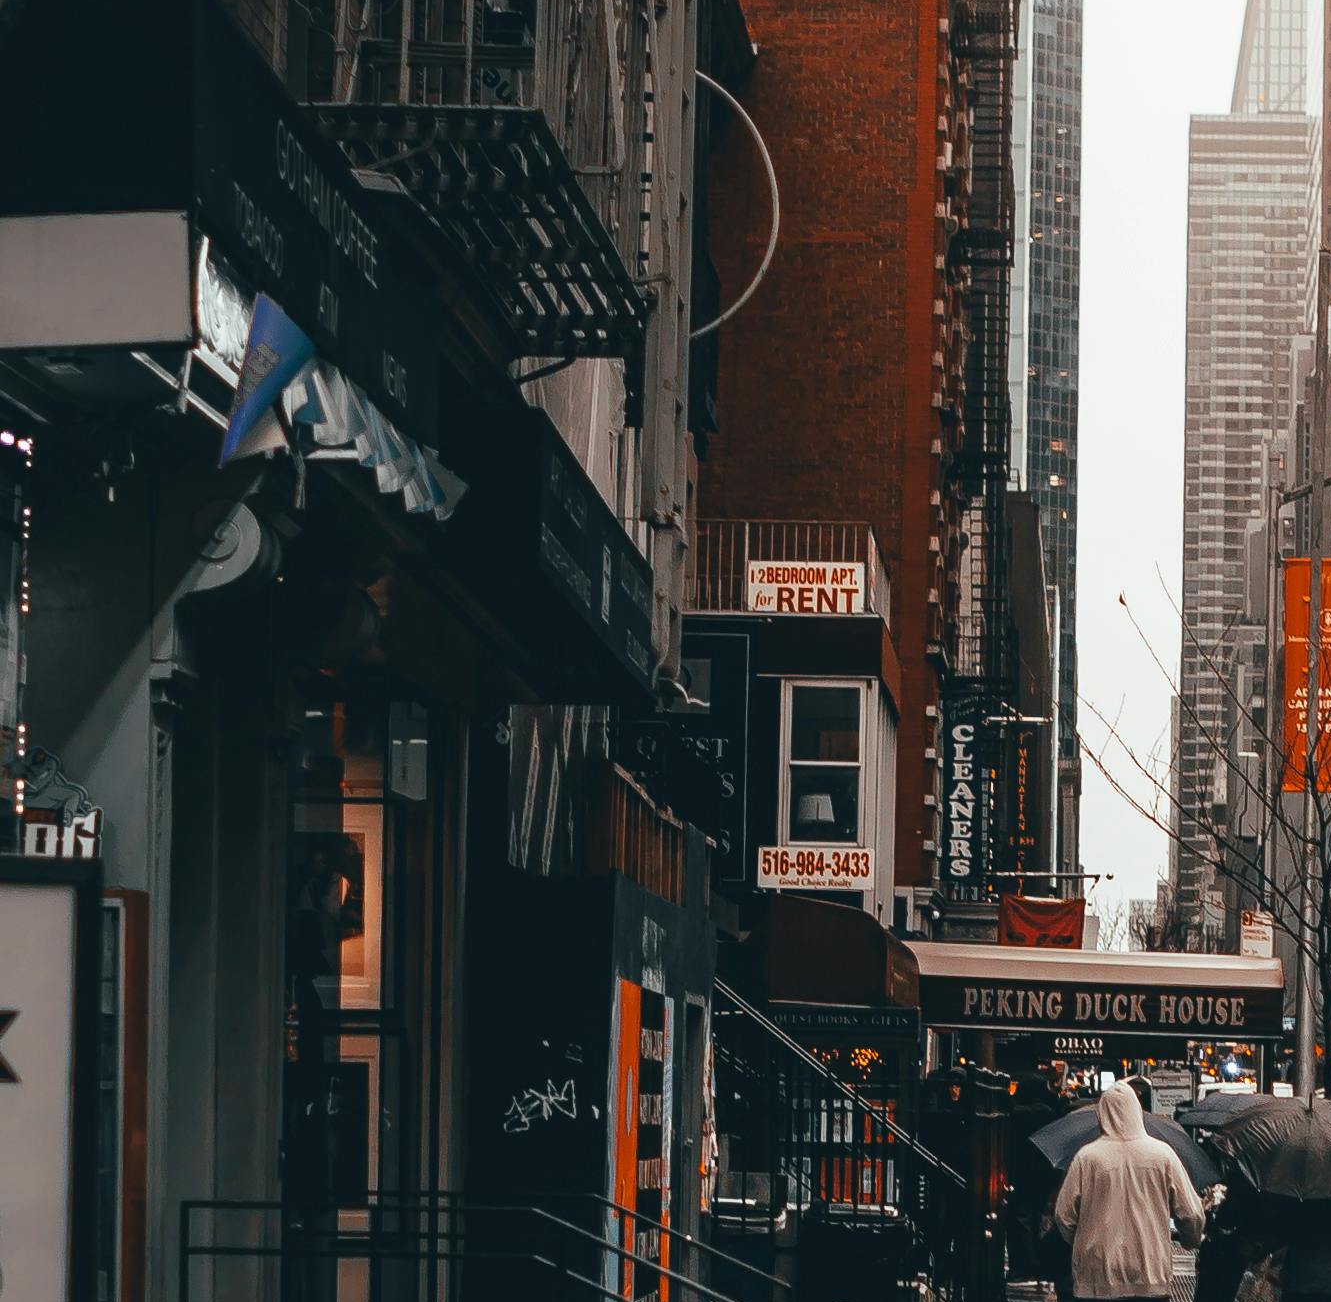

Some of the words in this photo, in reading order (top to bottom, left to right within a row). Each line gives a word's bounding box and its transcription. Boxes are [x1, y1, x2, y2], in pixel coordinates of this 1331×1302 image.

[333, 189, 378, 290] COFFEE
[830, 568, 858, 586] APT.
[752, 590, 774, 612] for
[777, 586, 859, 614] RENT
[949, 724, 976, 876] CLEANERS
[762, 850, 870, 878] 516-984-3433
[817, 1014, 859, 1026] BOOKS
[963, 987, 1063, 1020] PEKING
[1075, 992, 1147, 1024] DUCK
[1158, 994, 1246, 1026] HOUSE
[1054, 1037, 1103, 1049] OBAO
